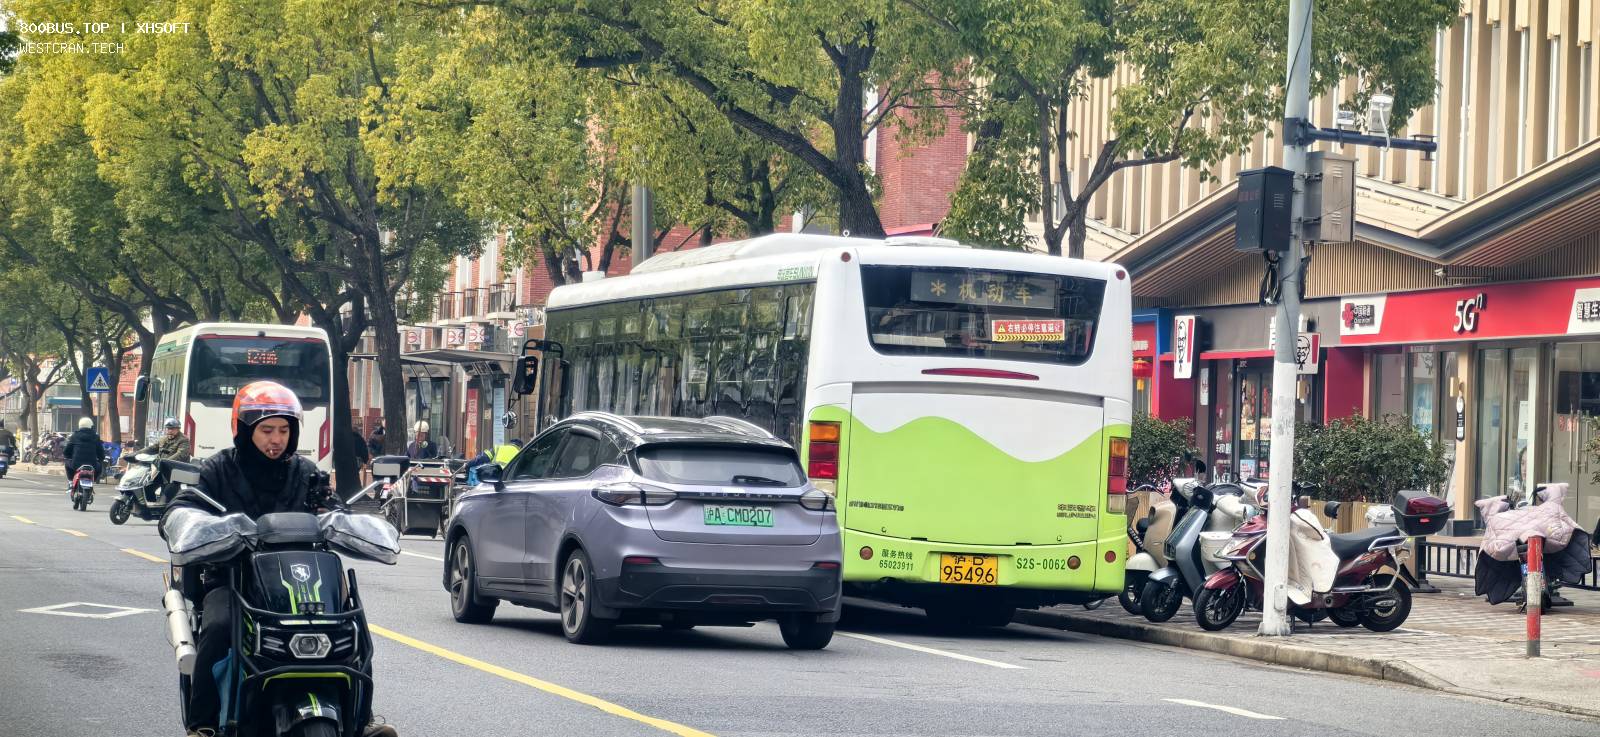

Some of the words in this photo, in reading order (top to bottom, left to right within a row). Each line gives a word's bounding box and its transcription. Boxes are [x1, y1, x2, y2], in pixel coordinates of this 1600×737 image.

[959, 280, 1033, 305] 机动车
[1576, 301, 1600, 319] 智慧生
[881, 548, 913, 560] 服务热线
[879, 559, 914, 572] 65023911
[1016, 557, 1066, 570] S2S-0062
[943, 565, 995, 583] 95496
